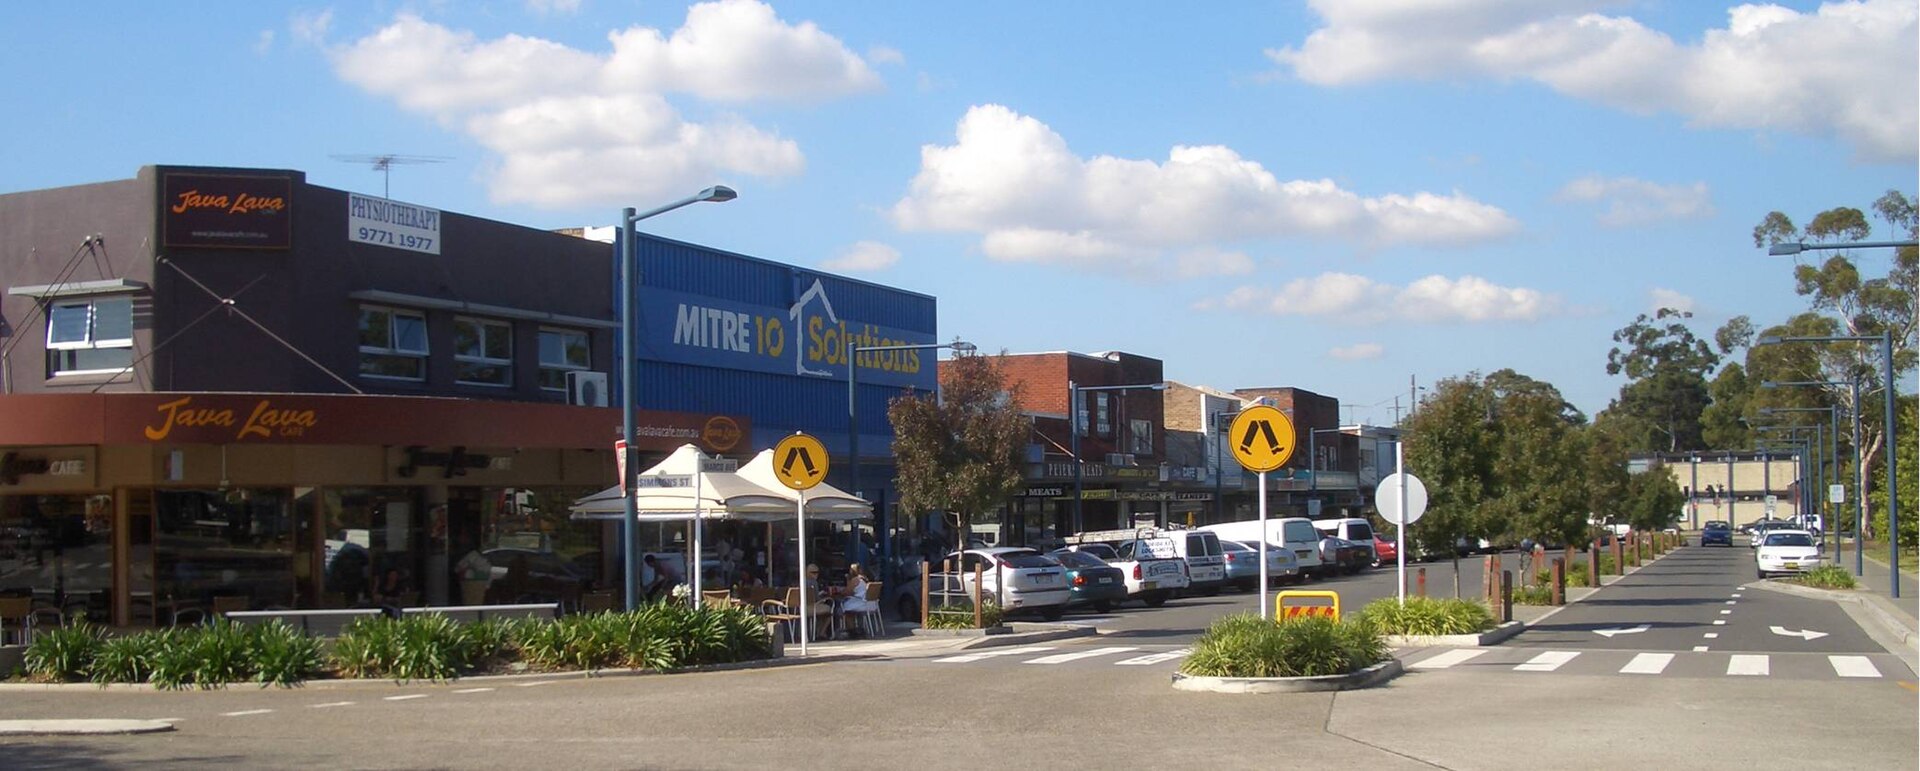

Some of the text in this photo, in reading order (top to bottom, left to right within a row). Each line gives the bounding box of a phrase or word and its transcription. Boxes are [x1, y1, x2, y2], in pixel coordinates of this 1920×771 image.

[172, 189, 285, 213] Java Lava
[351, 196, 438, 231] PHYSIOTHERAPY
[359, 227, 433, 250] 9771 1977
[673, 303, 785, 358] MITRE 10
[808, 316, 921, 373] Solutions
[144, 396, 318, 440] Java Lava
[639, 478, 689, 487] SIMMONS ST
[1028, 488, 1063, 496] MEATS
